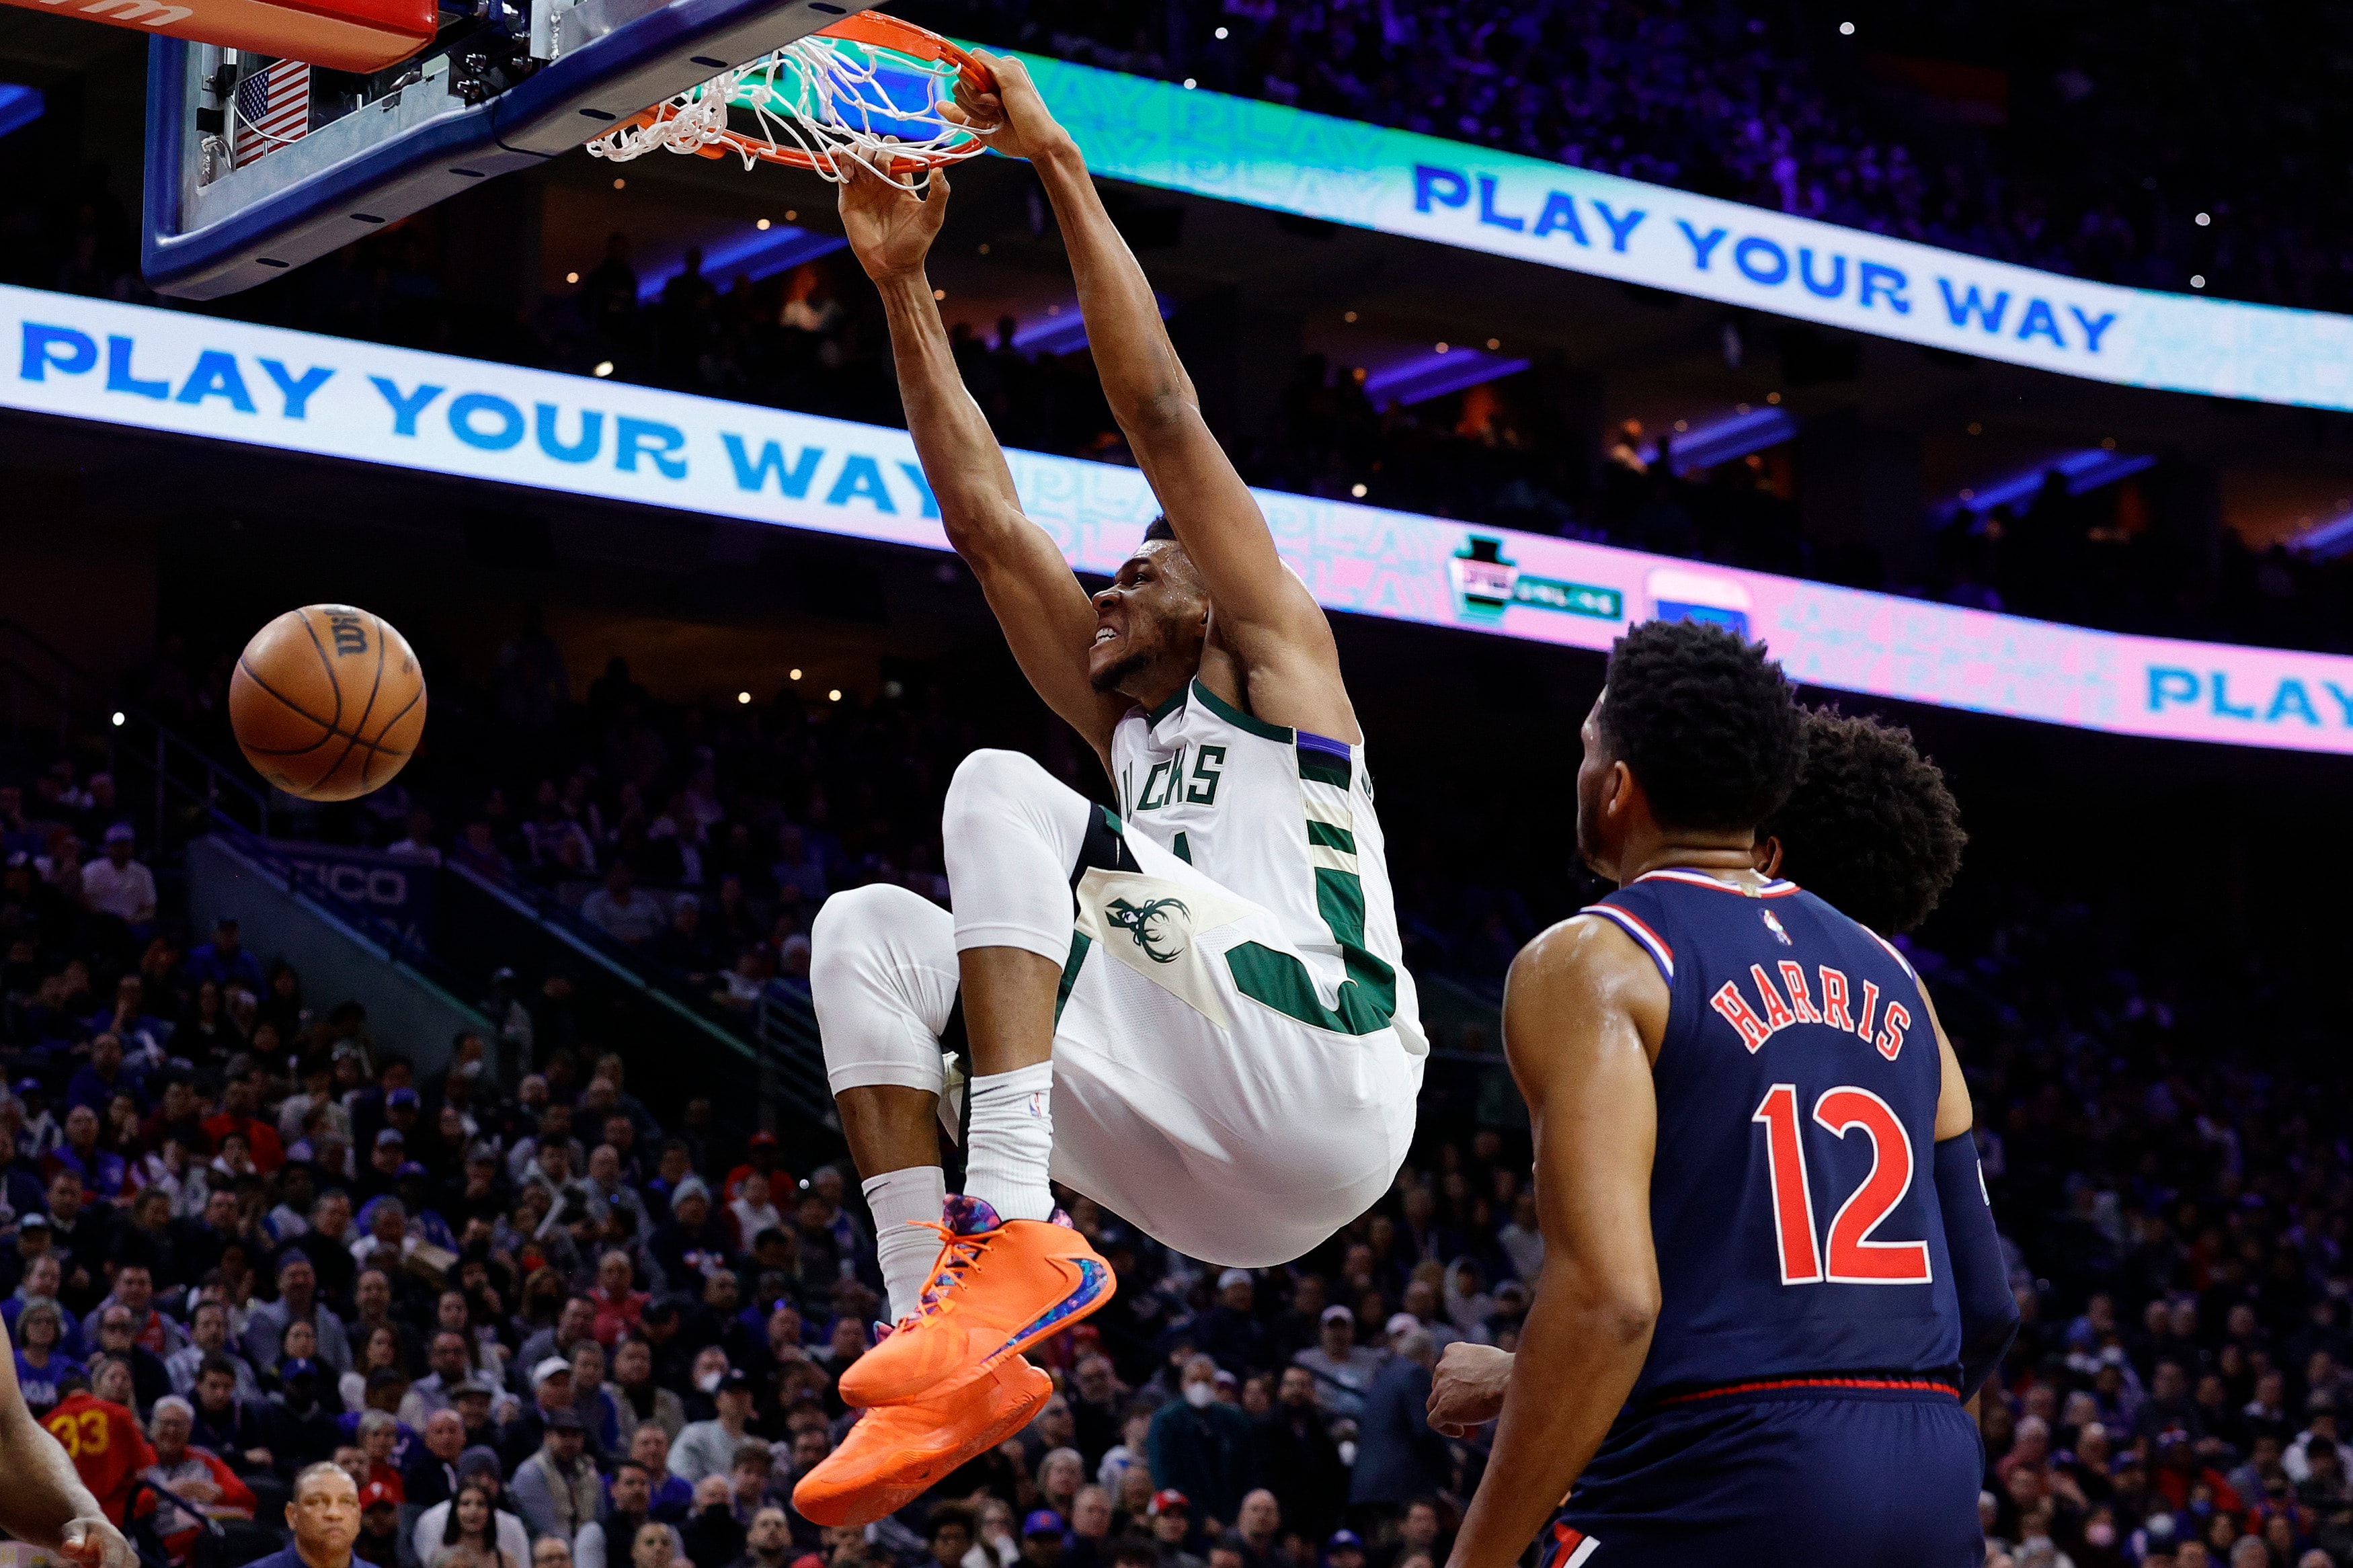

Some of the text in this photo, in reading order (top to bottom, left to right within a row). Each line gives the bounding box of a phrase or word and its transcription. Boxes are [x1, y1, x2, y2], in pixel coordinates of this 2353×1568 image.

[1414, 165, 2117, 354] PLAY YOUR WAY
[19, 321, 337, 421] PLAY
[368, 374, 688, 480] YOUR
[1710, 960, 1911, 1061] HARRIS
[1751, 1083, 1933, 1286] 12
